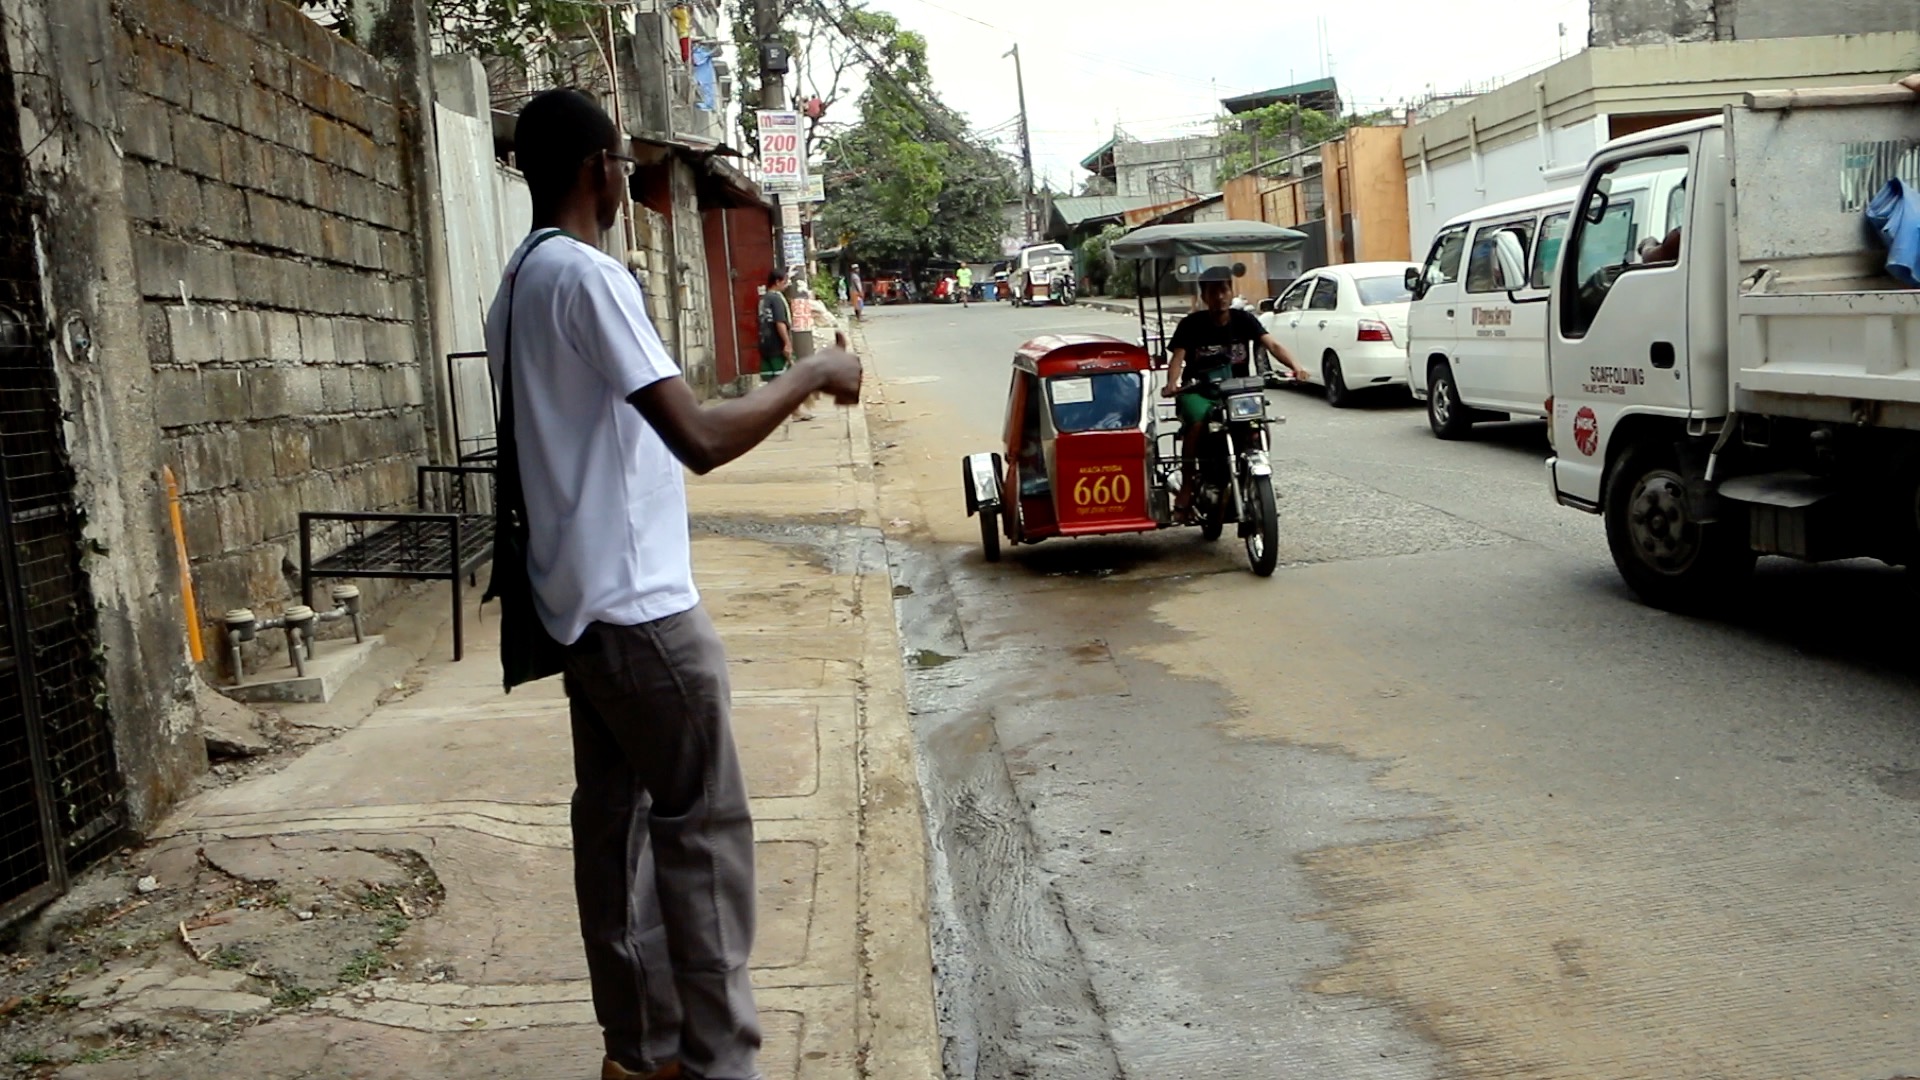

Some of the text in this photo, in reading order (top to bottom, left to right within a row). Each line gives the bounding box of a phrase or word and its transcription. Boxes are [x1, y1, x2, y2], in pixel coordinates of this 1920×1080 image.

[763, 135, 796, 152] 200
[763, 156, 796, 174] 350
[1590, 366, 1644, 385] SCAFFOLDING
[1073, 474, 1131, 505] 660
